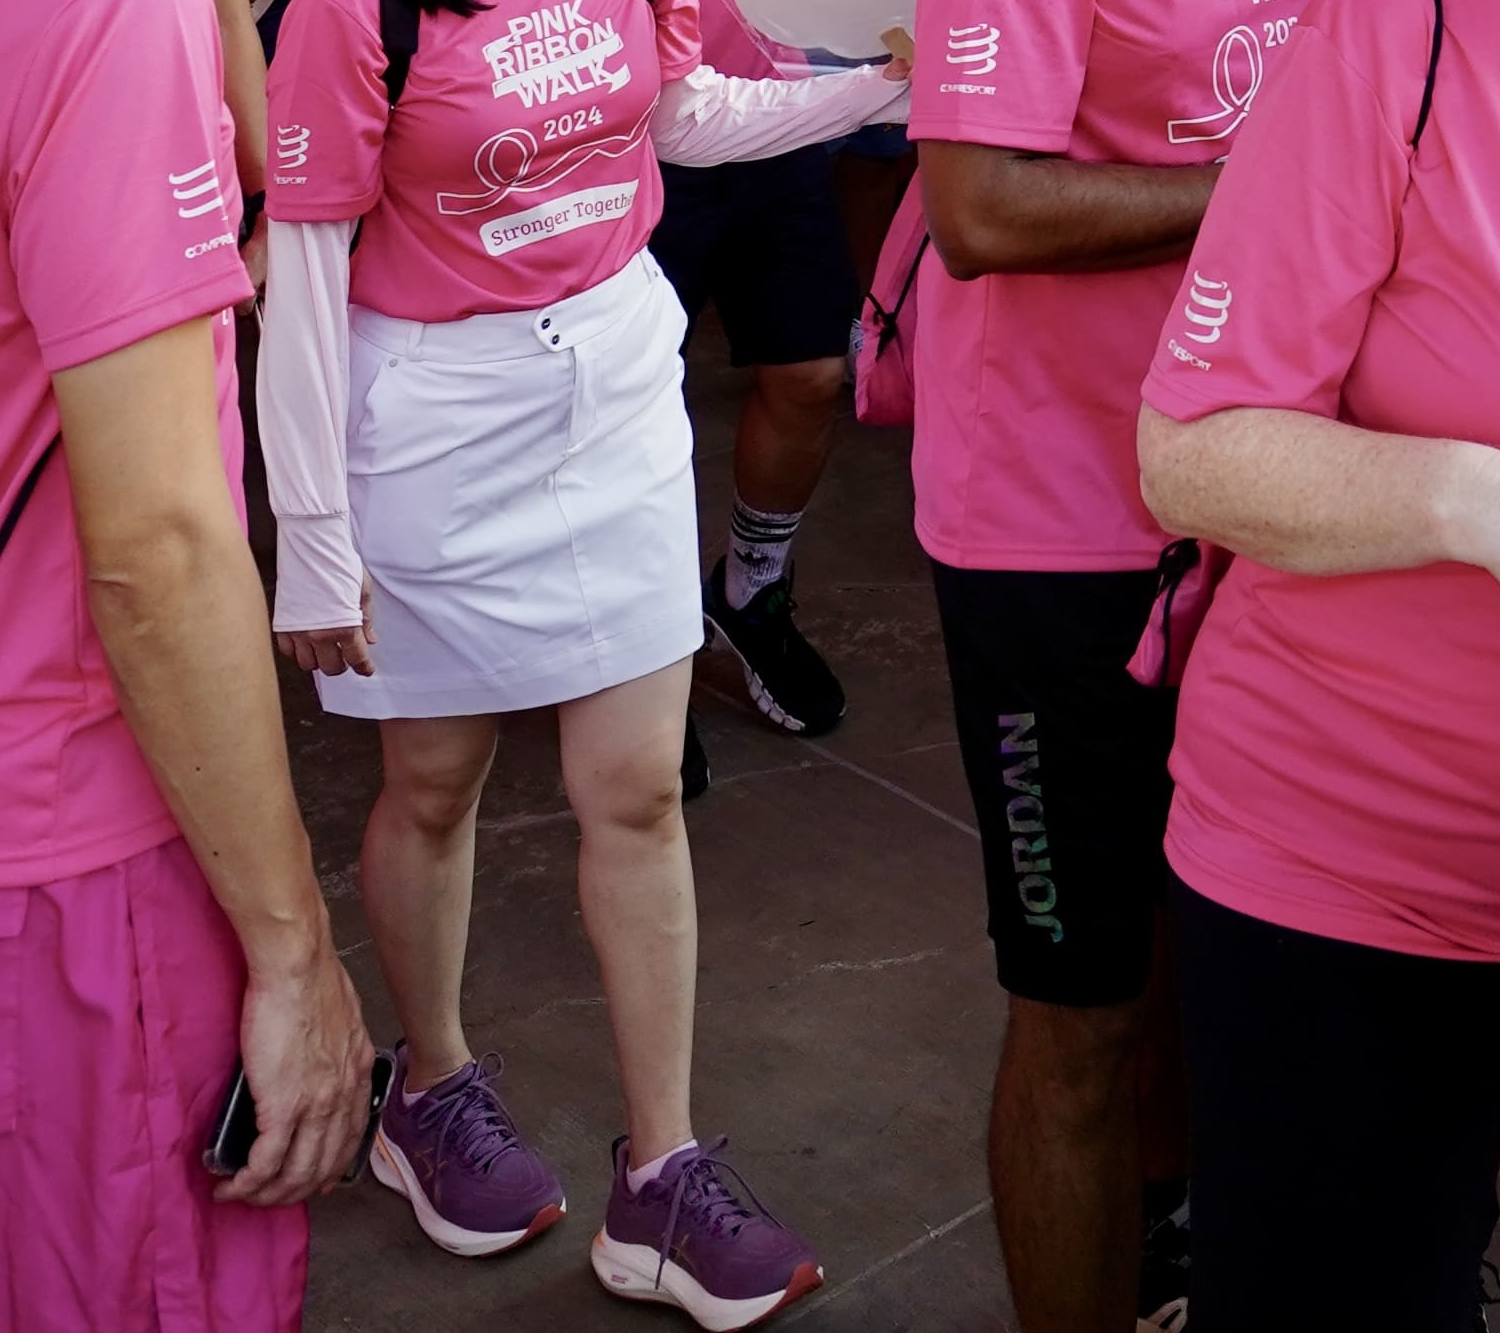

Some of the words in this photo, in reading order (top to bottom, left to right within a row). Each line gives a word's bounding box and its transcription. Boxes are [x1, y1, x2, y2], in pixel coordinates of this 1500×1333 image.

[491, 18, 615, 80] RIBBON
[515, 53, 612, 108] WALK
[543, 106, 604, 141] 2024
[491, 209, 570, 246] Stronger
[998, 712, 1064, 943] JORDAN
